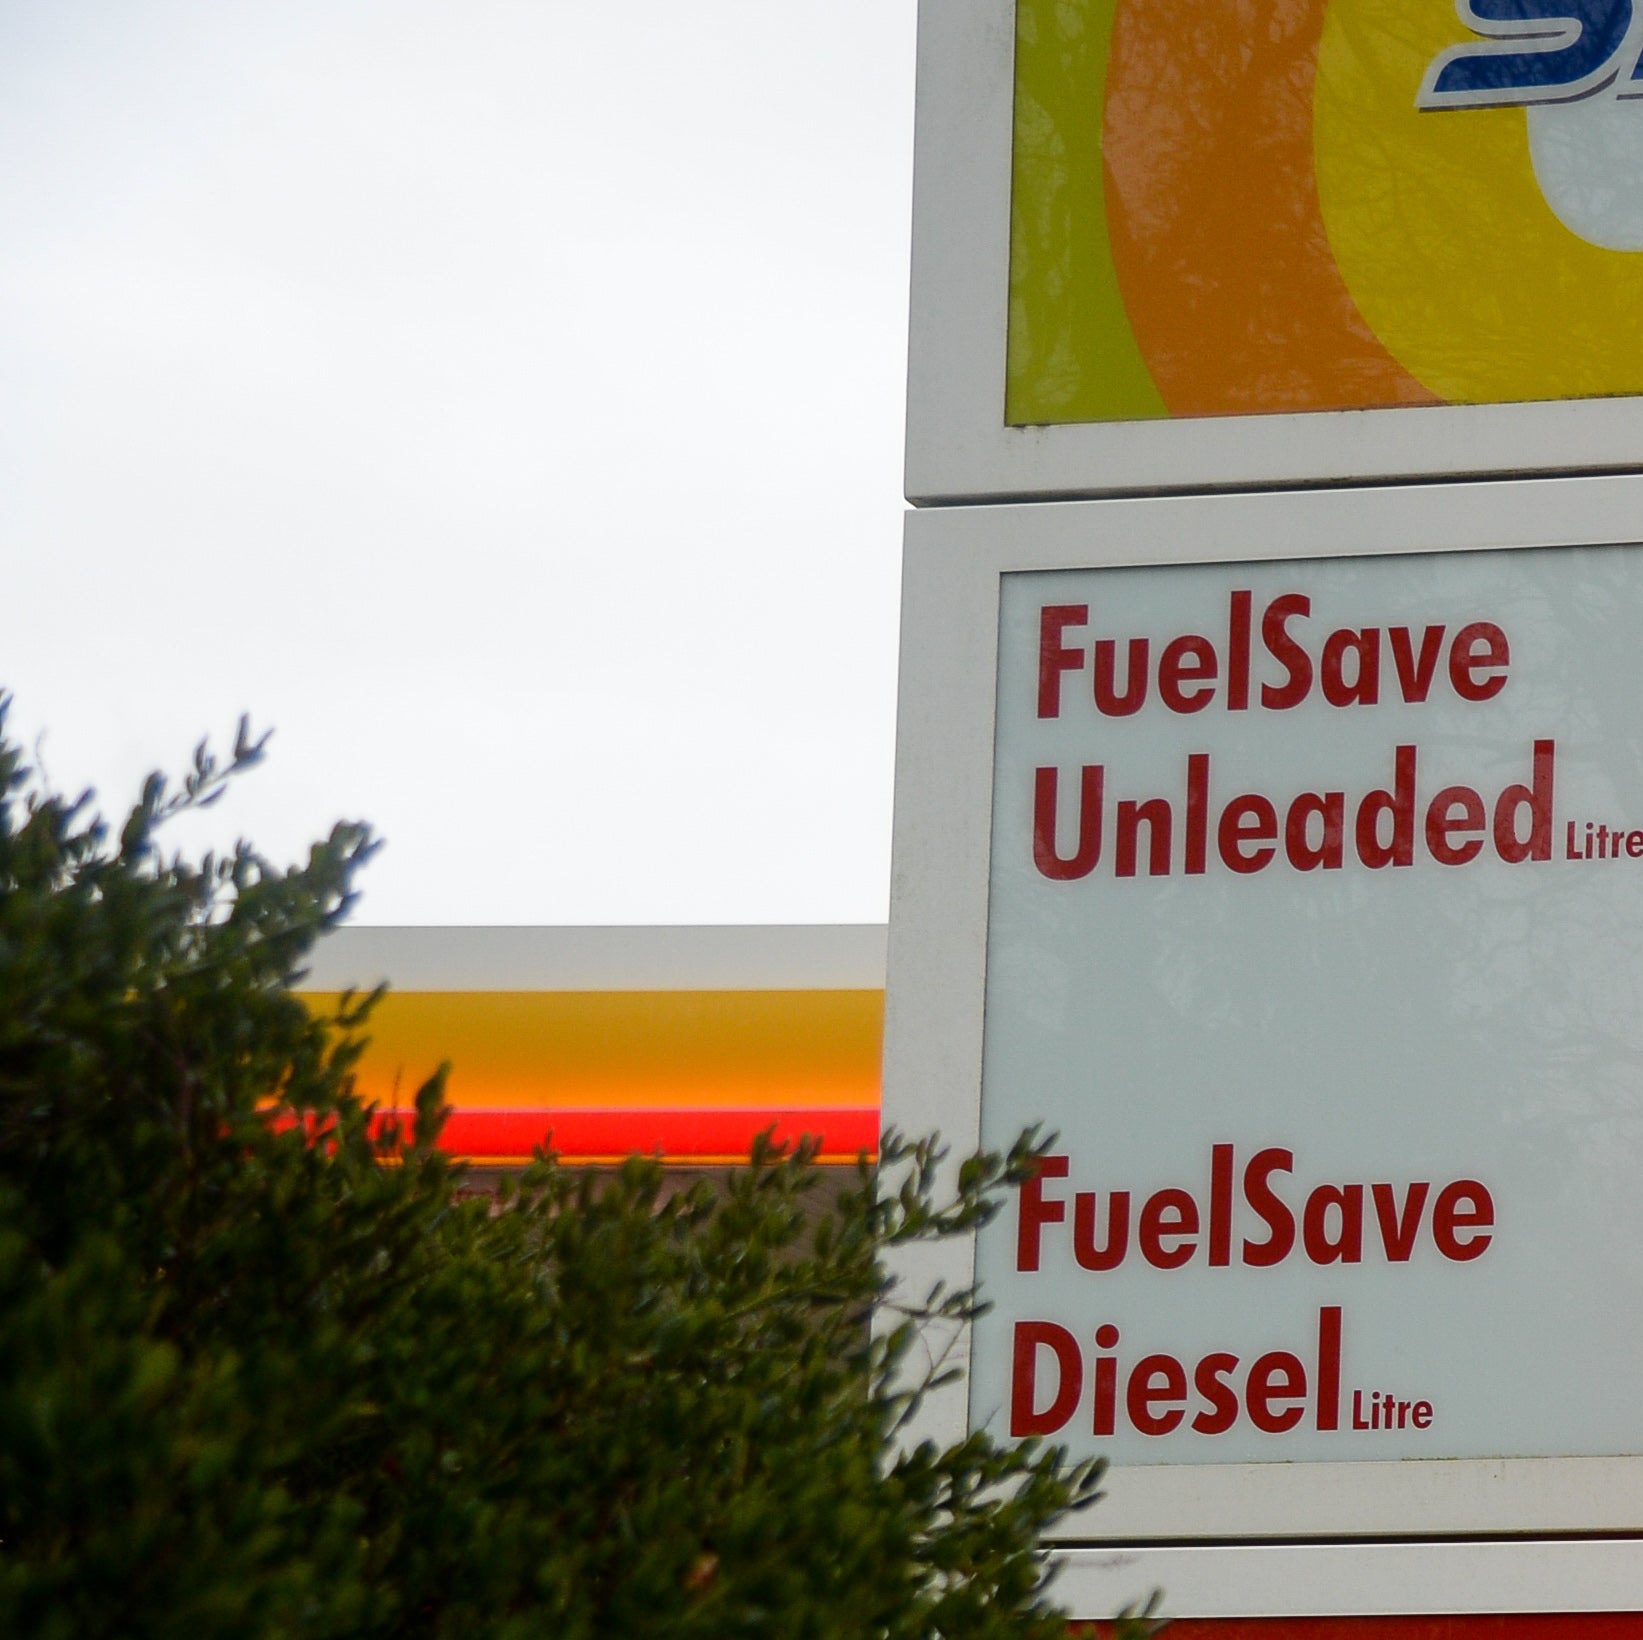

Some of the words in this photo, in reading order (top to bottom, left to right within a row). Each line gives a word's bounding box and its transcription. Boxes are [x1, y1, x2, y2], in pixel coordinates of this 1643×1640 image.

[1037, 590, 1510, 719] FuelSave
[1033, 739, 1555, 881] Unleaded
[1016, 1143, 1495, 1273] FuelSave
[1010, 1306, 1343, 1438] Diesel
[1352, 1389, 1434, 1431] Litre
